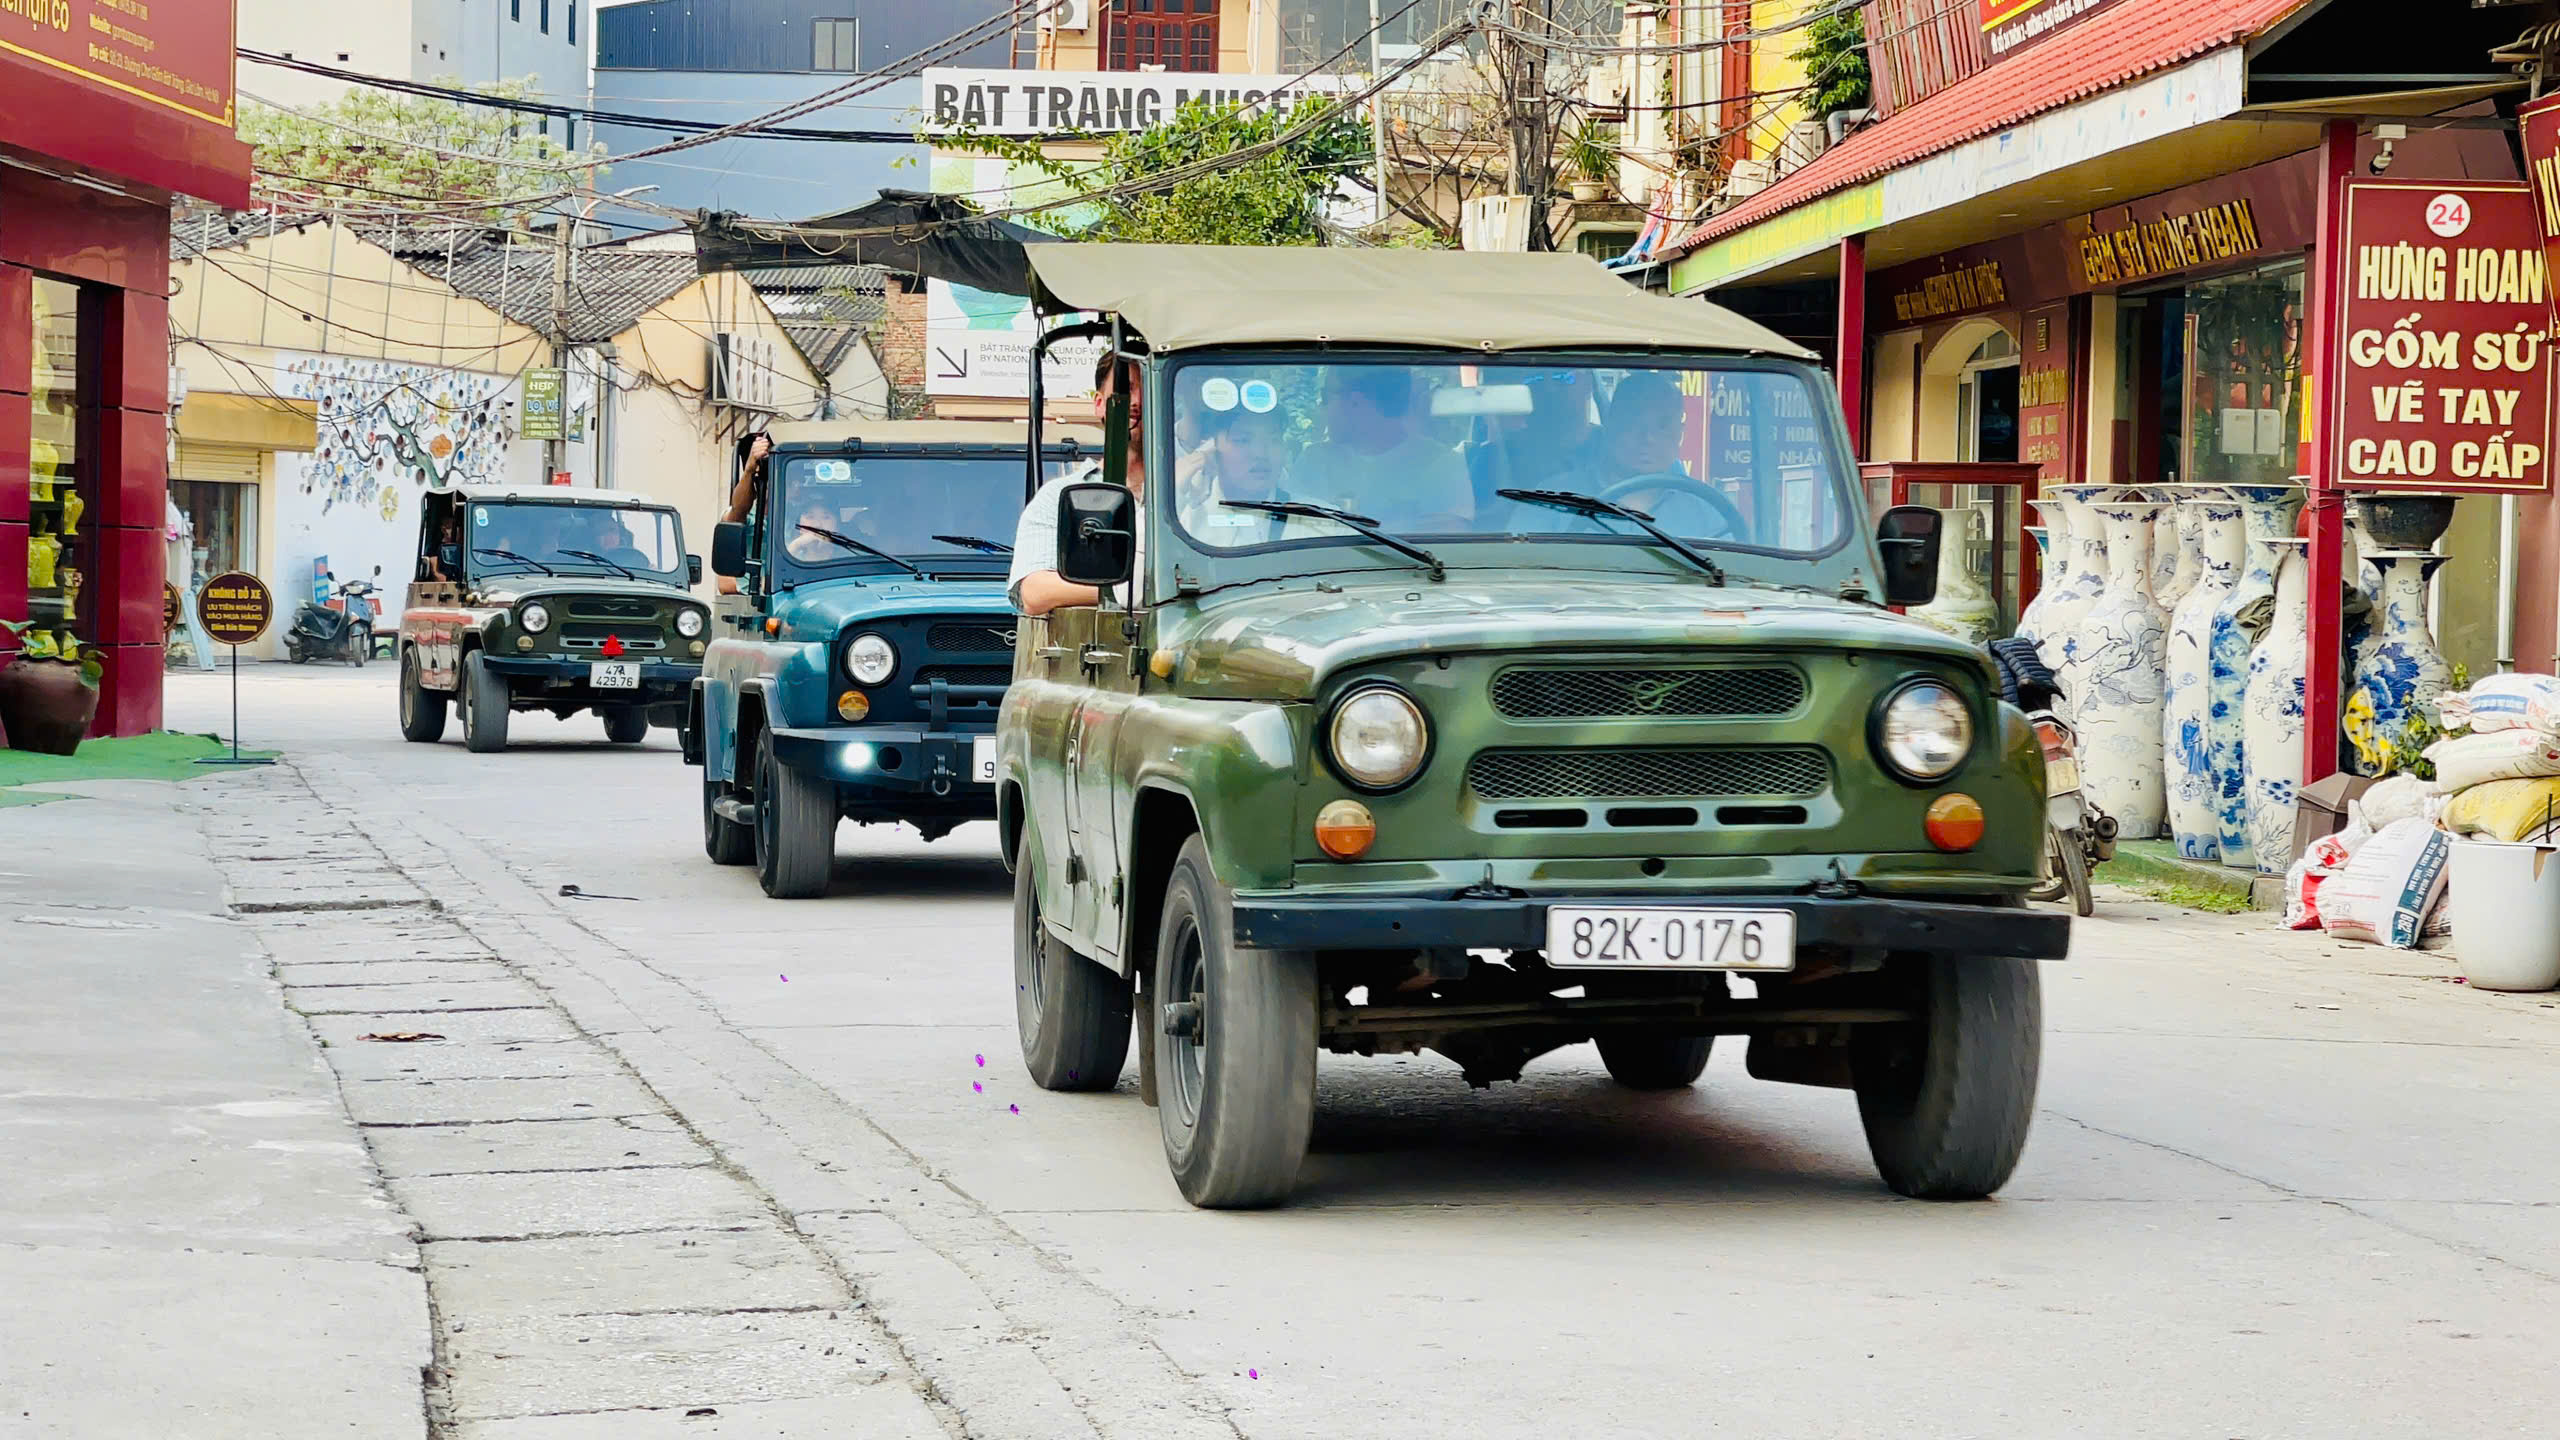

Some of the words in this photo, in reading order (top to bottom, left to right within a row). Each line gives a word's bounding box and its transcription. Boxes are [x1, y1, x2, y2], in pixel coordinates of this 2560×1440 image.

[1175, 88, 1358, 128] MUSE
[2431, 203, 2465, 226] 24
[2080, 211, 2121, 284] GỐM
[2116, 206, 2147, 277] SỨ
[2143, 211, 2199, 273] HƯNG
[2194, 199, 2259, 262] HOAN
[2358, 241, 2446, 301] HƯNG
[2455, 247, 2545, 304] HOAN
[980, 354, 992, 362] BY
[2349, 313, 2460, 370] GỐM
[2472, 322, 2547, 372] SỨ
[2371, 380, 2425, 423] VẼ
[2438, 388, 2520, 425] TAY
[2348, 439, 2437, 477] CAO
[2451, 430, 2541, 479] CẤP
[251, 589, 261, 600] XE
[596, 677, 633, 687] 429.76
[605, 665, 625, 676] 47A
[1573, 917, 1763, 961] 82K-0176
